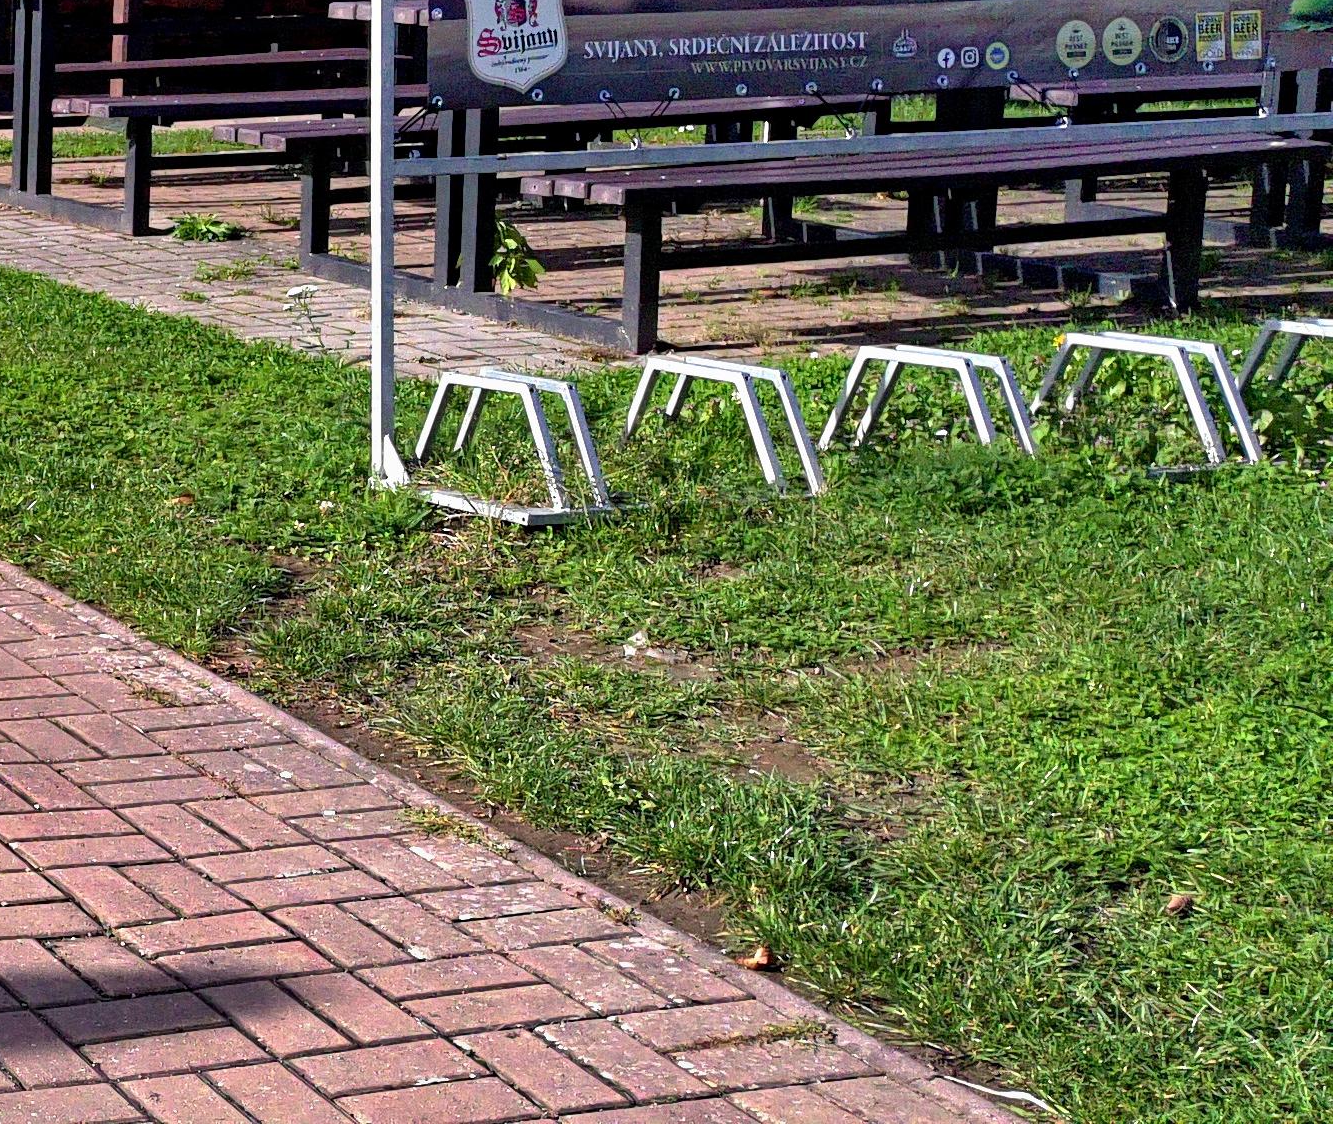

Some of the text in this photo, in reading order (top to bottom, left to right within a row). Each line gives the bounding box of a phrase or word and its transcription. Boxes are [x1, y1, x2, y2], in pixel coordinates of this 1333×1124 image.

[1198, 23, 1222, 34] BEER
[1233, 22, 1259, 34] BEER
[476, 28, 559, 58] Svijany
[583, 30, 869, 63] SVIJANY, SRDEČNÍ ZÁLEŽITOST
[691, 55, 869, 75] WWW.PIVOVARSVIJANY.CZ
